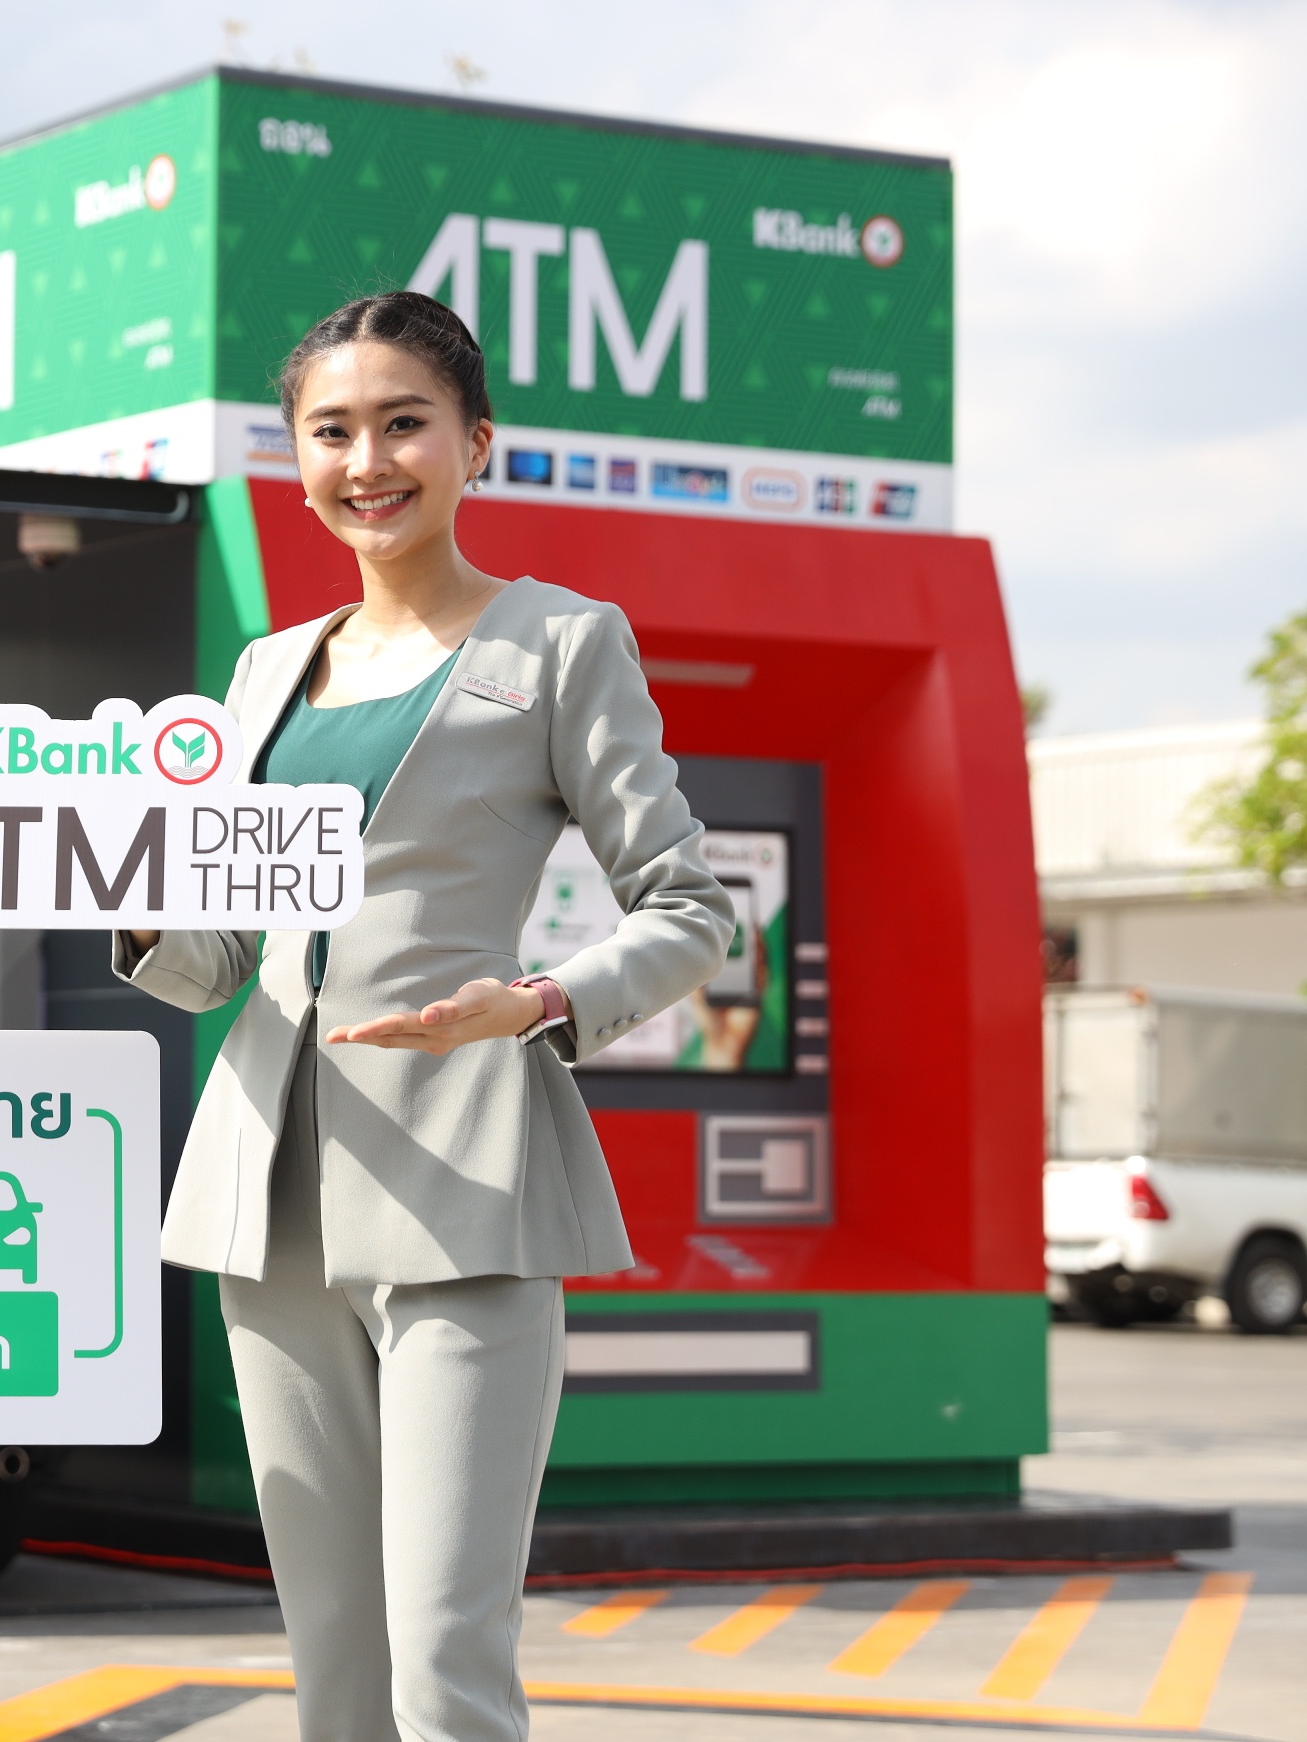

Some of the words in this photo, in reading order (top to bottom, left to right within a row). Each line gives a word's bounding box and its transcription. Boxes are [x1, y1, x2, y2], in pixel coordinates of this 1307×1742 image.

[753, 207, 859, 258] KBank
[466, 676, 499, 692] KBank
[191, 806, 344, 855] DRIVE
[190, 863, 344, 913] THRU
